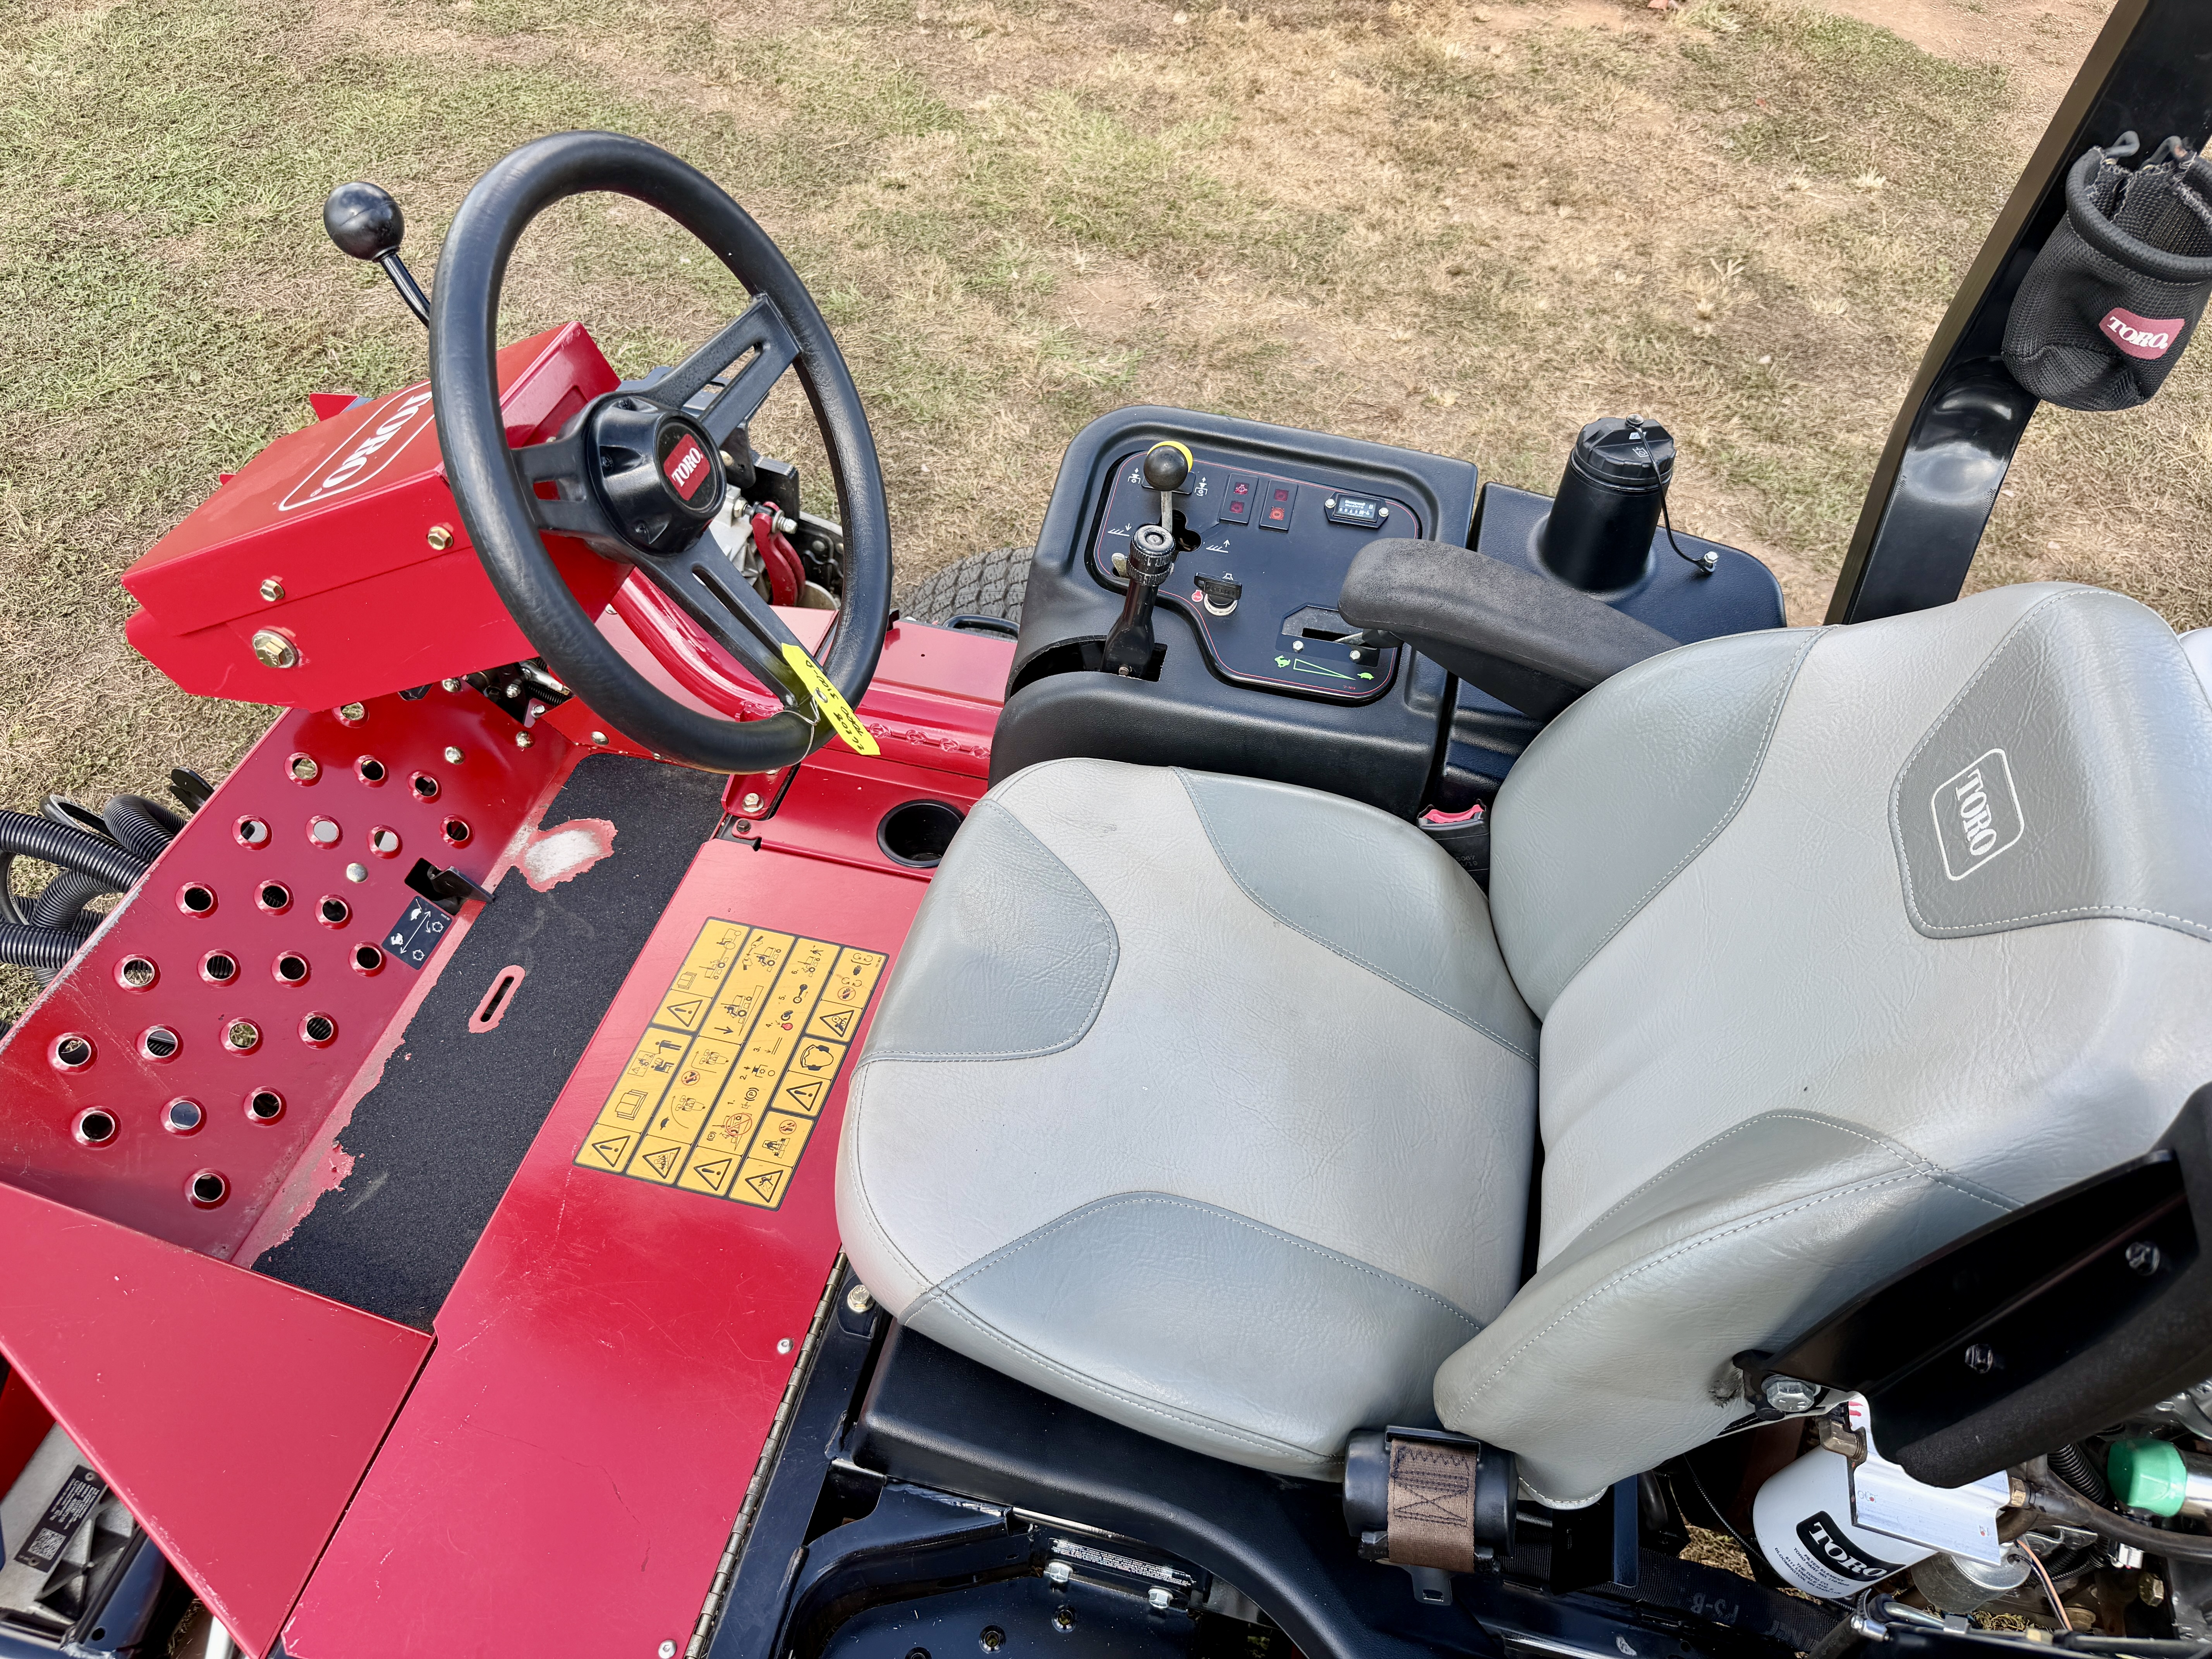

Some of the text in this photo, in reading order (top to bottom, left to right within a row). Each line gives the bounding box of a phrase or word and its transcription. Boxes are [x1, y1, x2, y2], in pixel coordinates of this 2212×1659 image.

[2107, 316, 2168, 349] TORO
[672, 448, 701, 487] TORO
[1956, 768, 1997, 855] TORO
[1775, 1547, 1806, 1582] BLOOMINGTON,
[1794, 1547, 1806, 1561] TORO
[1805, 1561, 1819, 1572] PART
[1809, 1522, 1887, 1576] TORO
[1785, 1556, 1795, 1567] 8111
[1795, 1567, 1817, 1584] LYNDALE
[1797, 1563, 1806, 1572] THE
[1806, 1571, 1820, 1582] TORO
[1804, 1554, 1845, 1582] FILTER ELEMENT
